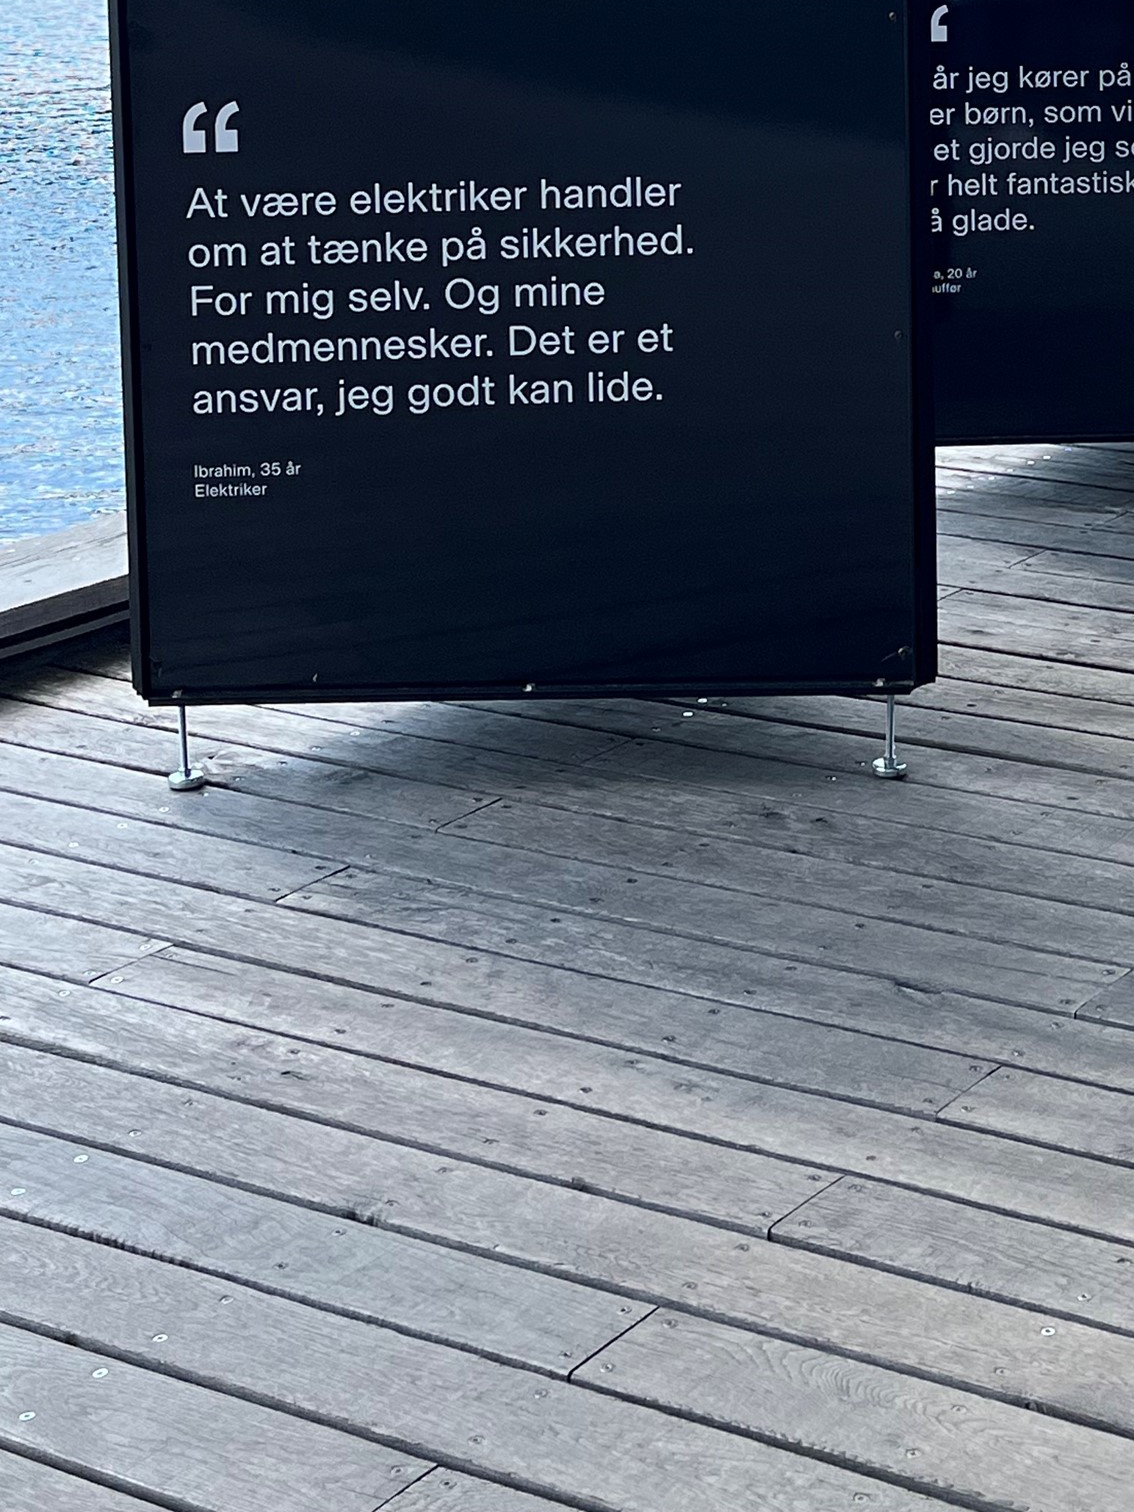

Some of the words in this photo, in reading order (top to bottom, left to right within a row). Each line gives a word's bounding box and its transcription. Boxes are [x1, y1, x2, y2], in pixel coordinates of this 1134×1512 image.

[965, 65, 1009, 94] jeg
[1019, 65, 1090, 89] kører
[1099, 62, 1132, 92] på
[964, 101, 1034, 128] børn,
[1043, 105, 1102, 124] som
[968, 136, 1056, 166] gjorde
[1062, 135, 1105, 164] jeg
[185, 187, 229, 219] At
[240, 191, 337, 217] være
[349, 180, 528, 215] elektriker
[540, 176, 682, 210] handler
[948, 172, 998, 197] helt
[952, 207, 1035, 237] glade.
[188, 243, 247, 268] om
[260, 235, 296, 266] at
[307, 231, 428, 265] tænke
[441, 226, 487, 268] på
[500, 223, 694, 260] sikkerhed.
[948, 268, 962, 278] 20
[966, 267, 977, 278] år
[191, 285, 253, 317] For
[266, 282, 334, 320] mig
[348, 280, 430, 313] selv.
[444, 277, 500, 315] Og
[514, 275, 605, 308] mine
[192, 327, 493, 365] medmennesker.
[509, 325, 575, 356] Det
[588, 330, 626, 354] er
[637, 323, 674, 353] et
[193, 387, 324, 417] ansvar,
[334, 379, 394, 417] jeg
[407, 375, 496, 415] godt
[508, 373, 574, 405] kan
[588, 370, 663, 403] lide.
[194, 463, 256, 479] Ibrahim,
[260, 461, 282, 477] 35
[285, 460, 302, 476] år
[194, 482, 268, 498] Elektriker
